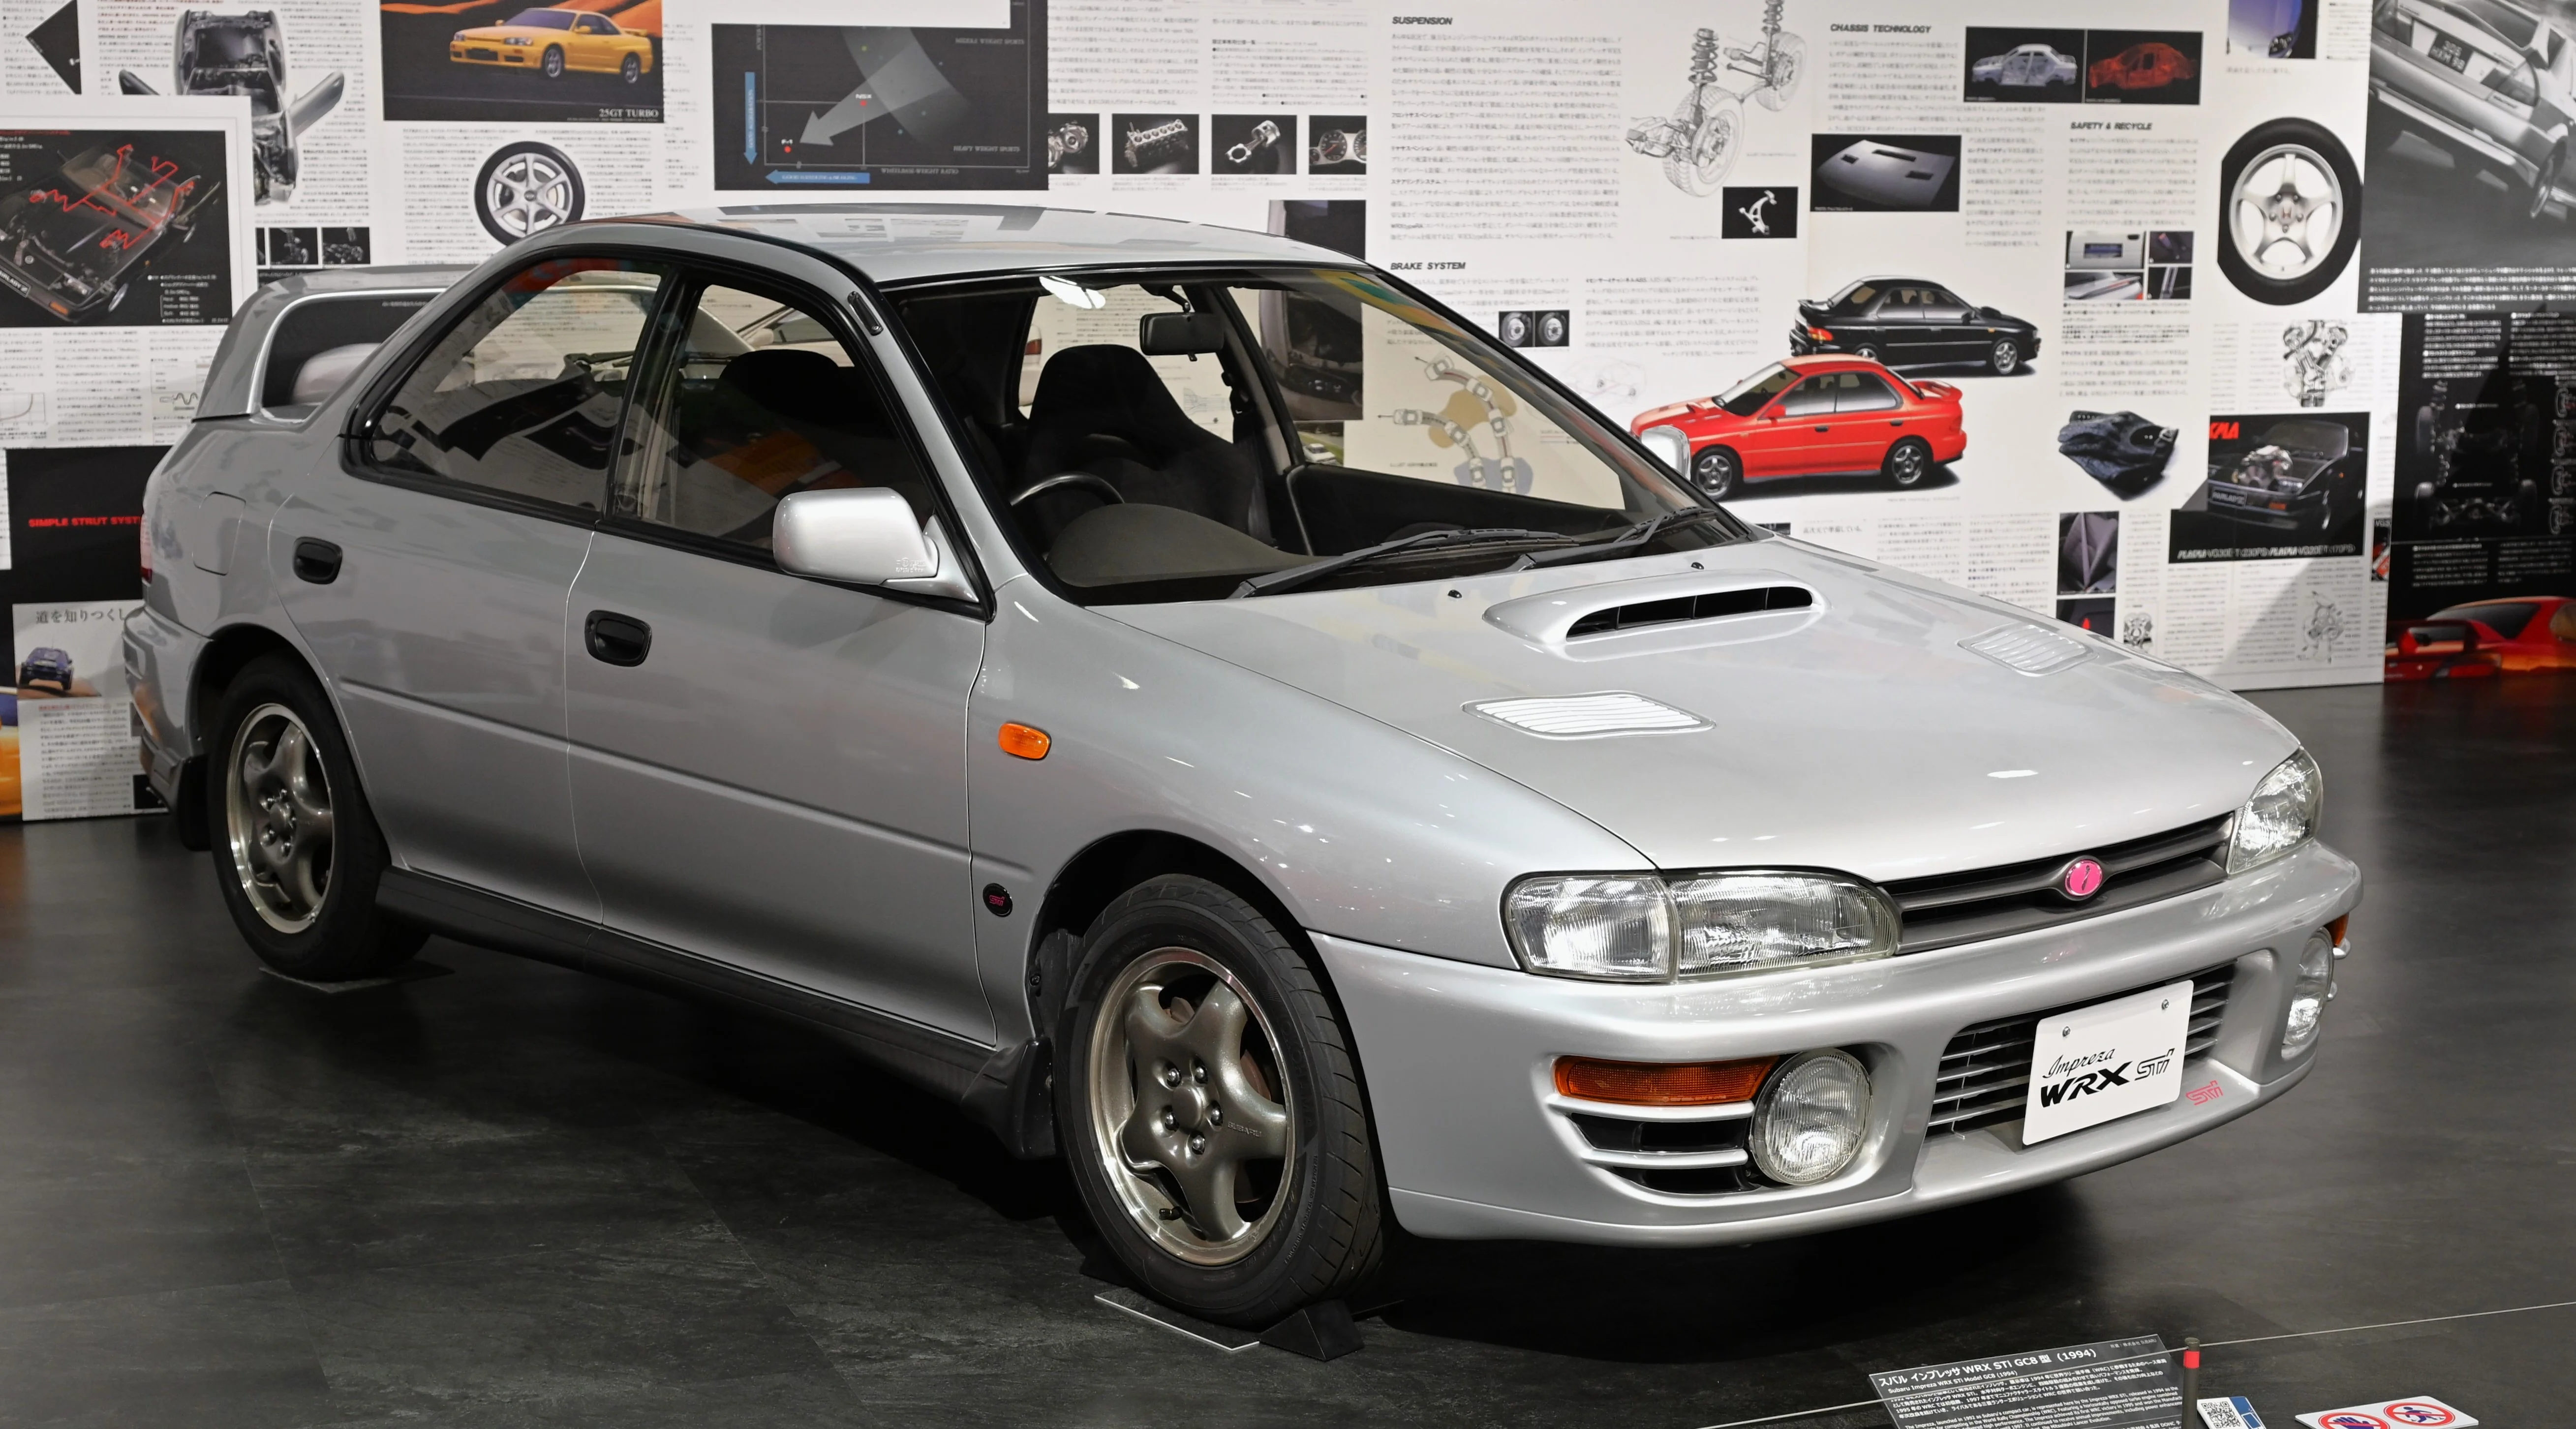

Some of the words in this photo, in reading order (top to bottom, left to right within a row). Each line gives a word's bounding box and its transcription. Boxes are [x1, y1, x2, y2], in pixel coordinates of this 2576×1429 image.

[1392, 16, 1453, 26] SUSPENSION
[1830, 23, 1869, 32] CHASSIS
[1872, 24, 1932, 34] TECHNOLOGY
[599, 108, 624, 119] 25GT
[626, 108, 659, 119] TURBO
[2070, 122, 2104, 130] SAFETY
[2114, 122, 2153, 131] RECYCLE
[1390, 262, 1422, 270] BRAKE
[1427, 262, 1466, 270] SYSTEM
[29, 517, 68, 527] SIMPLE
[71, 517, 107, 526] STRUT
[2042, 1048, 2116, 1078] Impreza
[2040, 1061, 2133, 1108] WRX
[1227, 1121, 1262, 1138] SUBARU
[1879, 1374, 1907, 1387] スバル
[1911, 1366, 1960, 1382] インプレッサ
[1962, 1362, 1992, 1375] WRX
[1993, 1359, 2012, 1370] STi
[2014, 1356, 2038, 1367] GC8
[2038, 1353, 2052, 1364] 型
[1888, 1385, 1909, 1394] Subaru
[1911, 1381, 1937, 1392] Impreza
[1996, 1369, 2018, 1379] (1994)
[1915, 1421, 1936, 1429] Impreza,
[2036, 1401, 2062, 1411] represented
[2009, 1410, 2040, 1421] Championship
[2057, 1404, 2079, 1413] Featuring
[2084, 1400, 2109, 1409] horizontally
